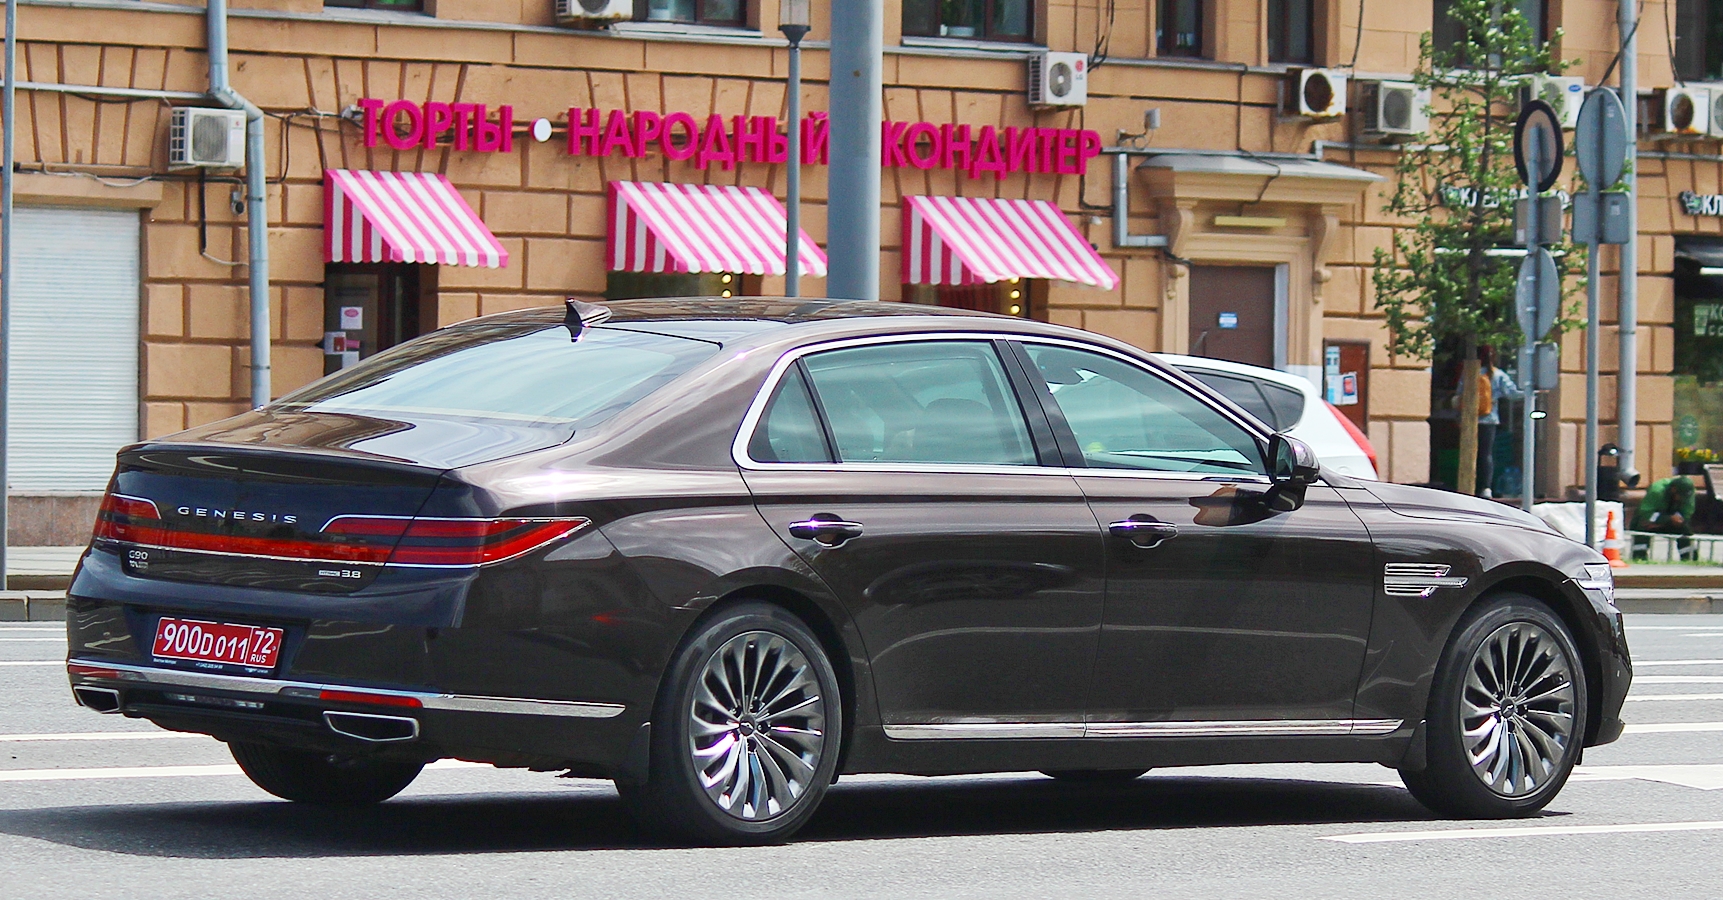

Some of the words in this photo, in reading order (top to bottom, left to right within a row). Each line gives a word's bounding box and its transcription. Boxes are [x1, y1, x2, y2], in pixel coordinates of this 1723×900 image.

[358, 98, 512, 152] ТОРТЫ
[882, 121, 1102, 181] КОНДИТЕР
[177, 506, 298, 524] GENESIS
[252, 630, 275, 654] 72
[250, 653, 266, 663] RUS
